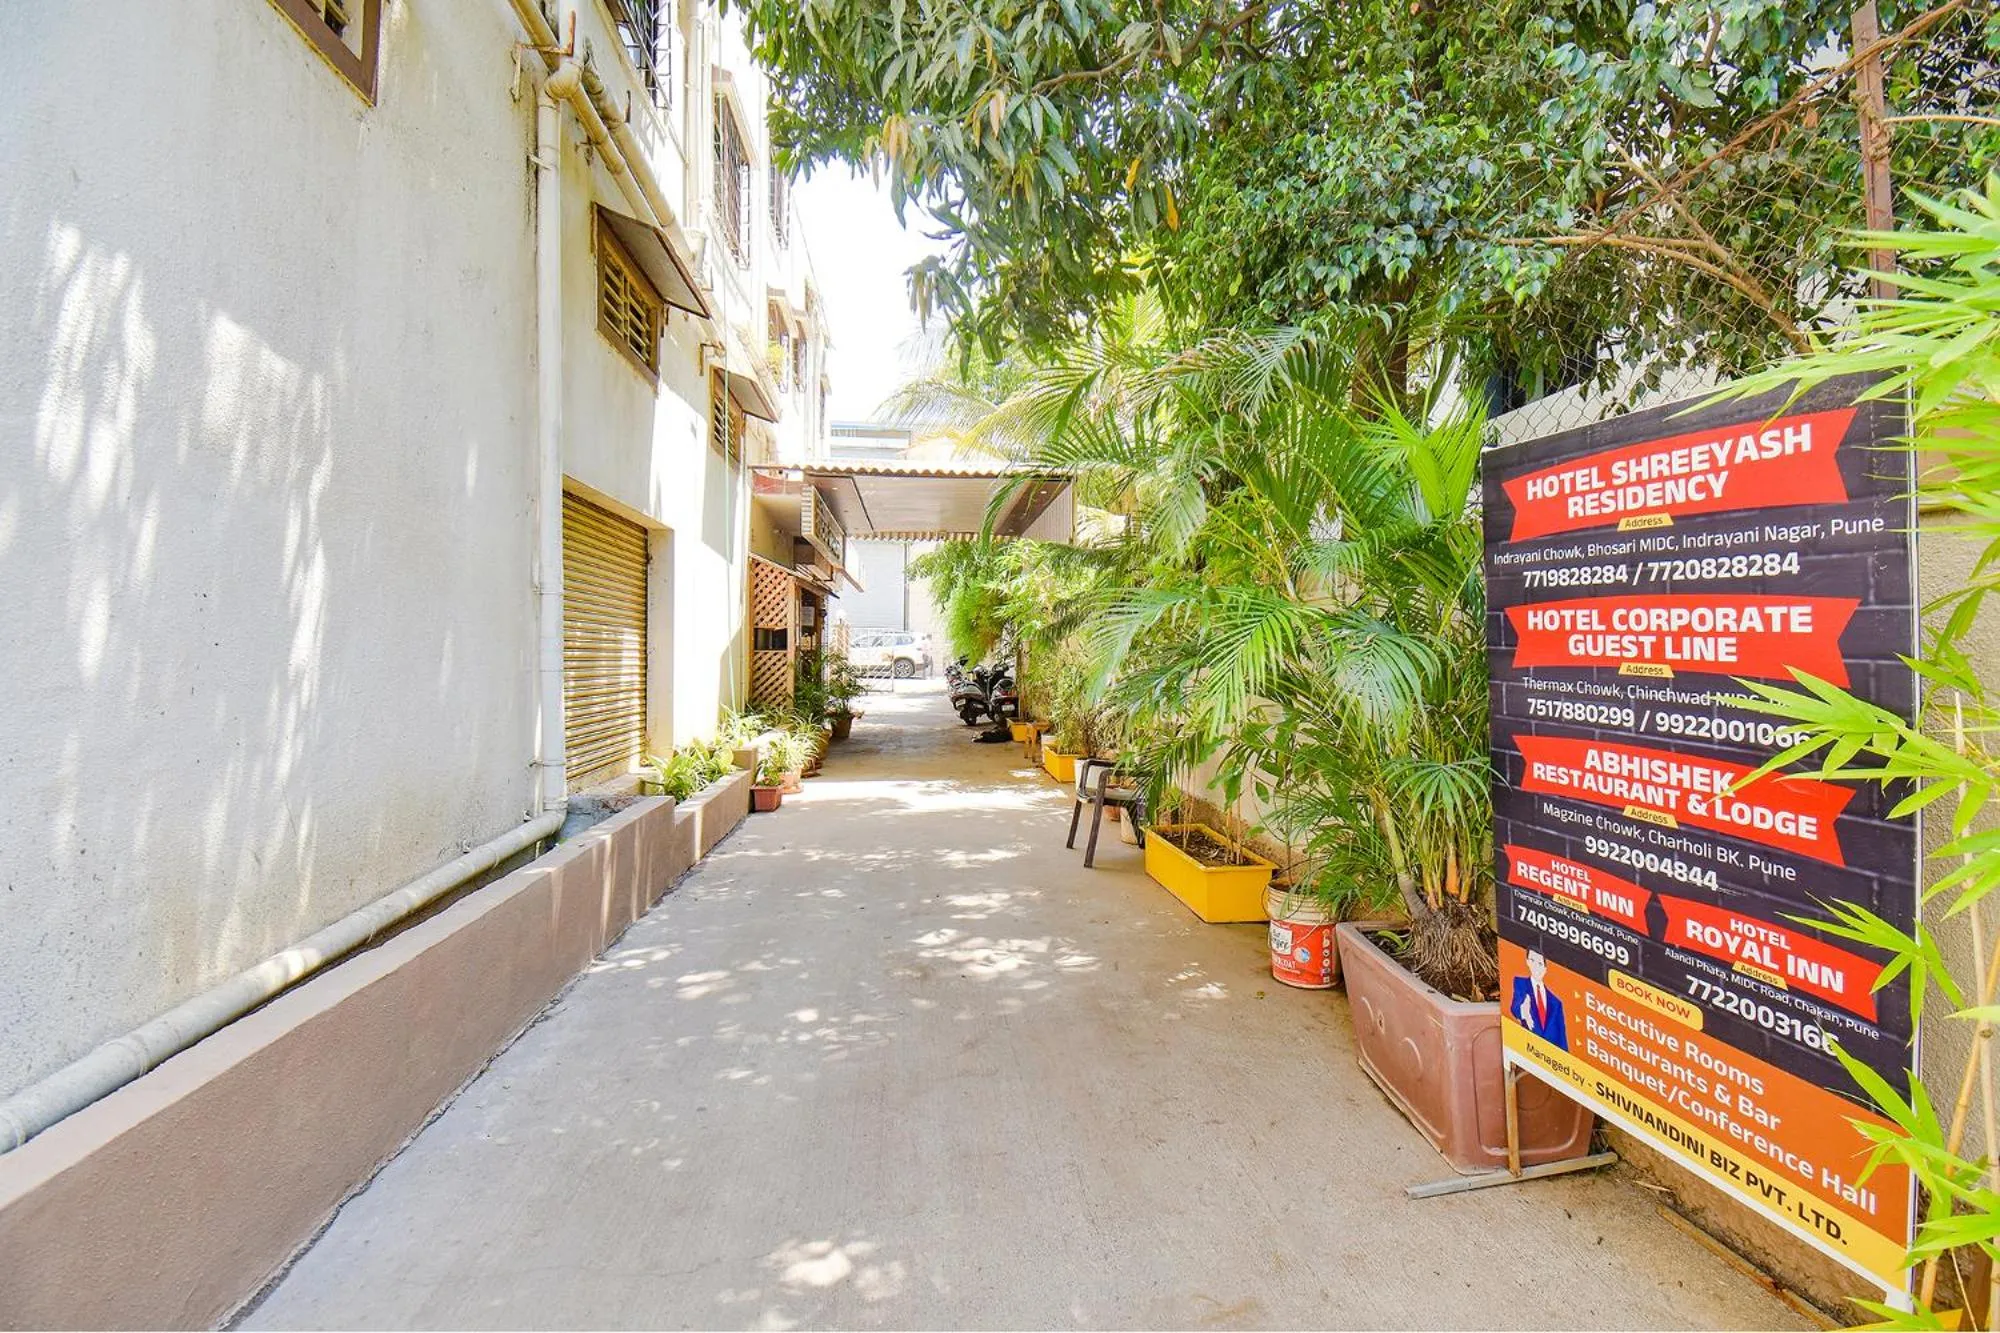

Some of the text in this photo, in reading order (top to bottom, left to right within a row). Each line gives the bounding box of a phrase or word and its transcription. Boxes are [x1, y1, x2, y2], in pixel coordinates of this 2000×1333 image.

[1526, 423, 1812, 501] HOTEL SHREEYASH
[1567, 471, 1729, 518] RESIDENCY
[1494, 515, 1884, 565] Indrayani Chowk, Bhosari MIDC, Indrayani Nagar, Pune
[1624, 516, 1664, 529] Address
[1523, 551, 1800, 588] 7719828284 / 7720828284
[1527, 605, 1813, 633] HOTEL CORPORATE
[1568, 633, 1738, 662] GUEST LINE
[1626, 664, 1664, 676] Address
[1522, 676, 1573, 693] Thermax
[1576, 681, 1623, 699] Chowk,
[1627, 684, 1710, 705] Chinchwad
[1527, 697, 1635, 729] 7517880299
[1639, 709, 1651, 733] /
[1584, 749, 1735, 798] ABHISHEK
[1532, 762, 1818, 841] RESTAURANT & LODGE
[1630, 807, 1669, 824] Address
[1543, 803, 1796, 882] Magzine Chowk, Charholi BK. Pune
[1584, 836, 1719, 891] 9922004844
[1516, 861, 1634, 918] REGENT INN
[1551, 860, 1591, 884] HOTEL
[1517, 905, 1629, 966] 7403996699
[1617, 930, 1639, 945] Pune
[1686, 919, 1845, 992] ROYAL INN
[1730, 918, 1791, 950] HOTEL
[1665, 948, 1880, 1040] Alandi Phata, MIDC Road, Chakan, Pune
[1740, 965, 1779, 984] Address
[1616, 978, 1692, 1020] BOOK NOW
[1585, 993, 1764, 1096] Executive Rooms
[1585, 1014, 1782, 1132] Restaurants & Bar
[1526, 1042, 1572, 1077] Managed
[1573, 1067, 1586, 1087] by
[1595, 1080, 1706, 1159] SHIVNANDINI
[1710, 1149, 1741, 1182] BIZ
[1745, 1171, 1793, 1213] PVT.
[1798, 1201, 1849, 1246] LTD.
[1586, 1038, 1878, 1216] Banquet/Conference Hall
